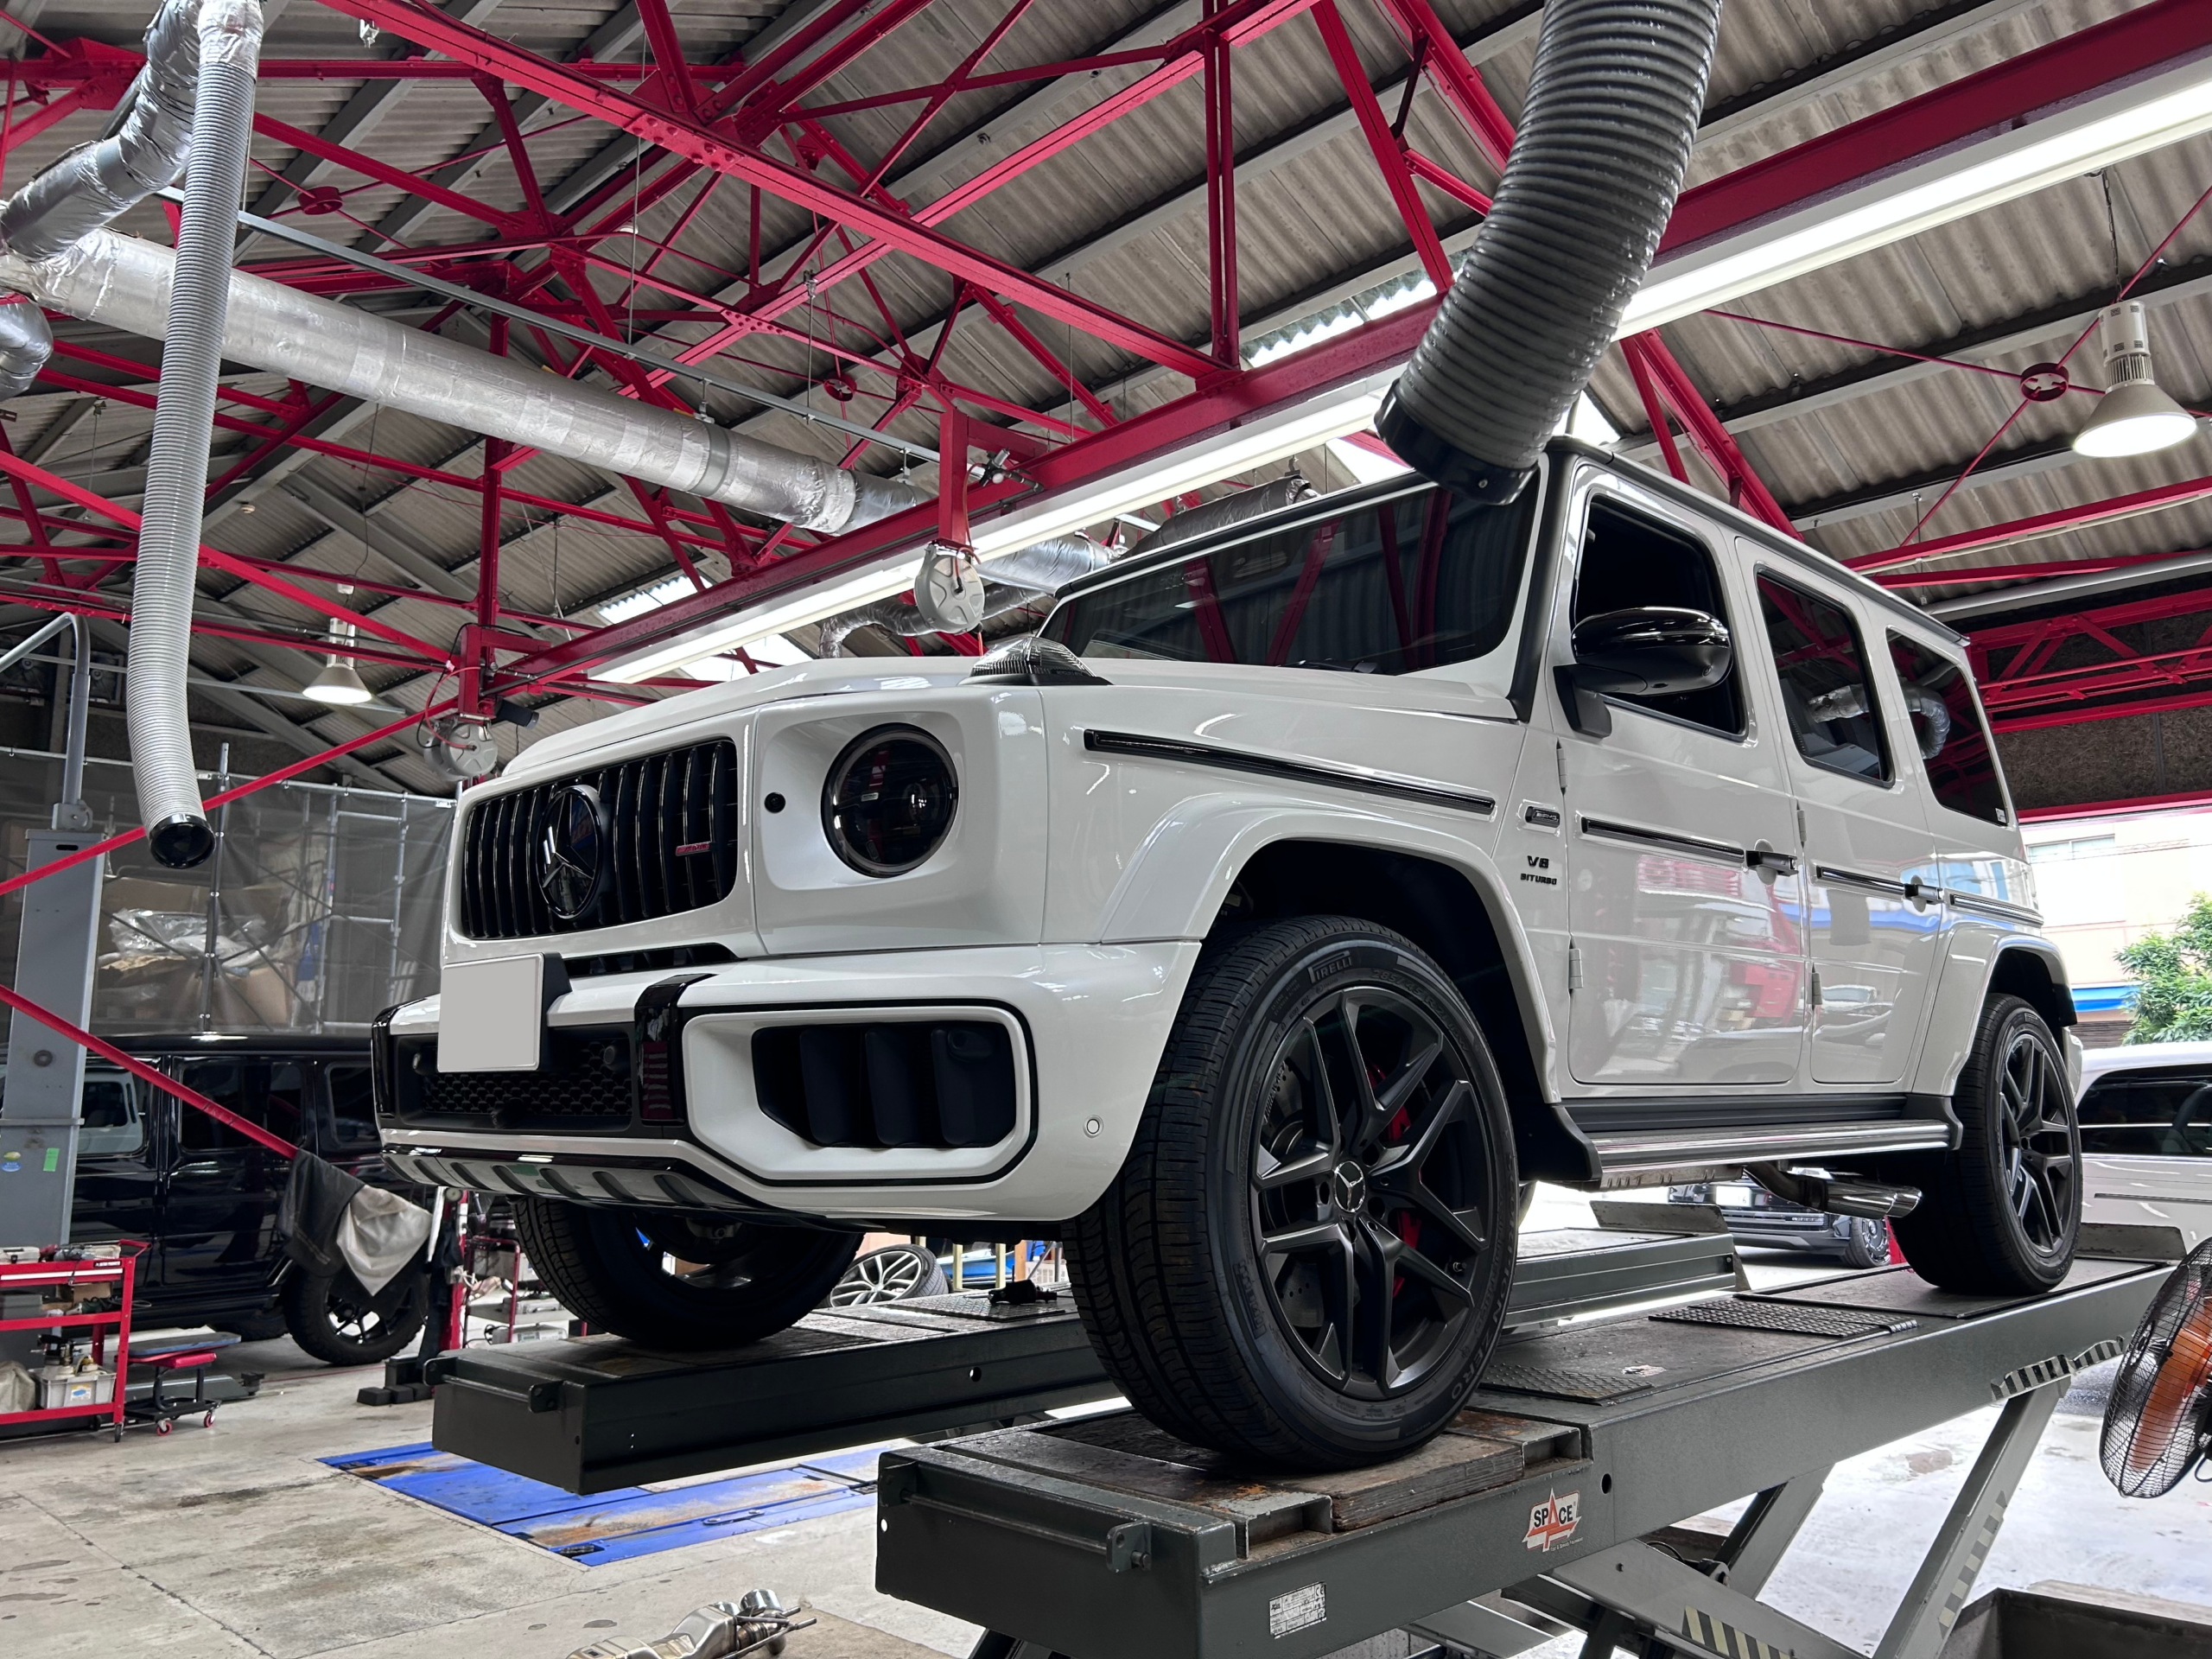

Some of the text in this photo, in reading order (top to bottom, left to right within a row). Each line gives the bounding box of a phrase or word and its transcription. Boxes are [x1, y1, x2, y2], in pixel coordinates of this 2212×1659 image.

[1527, 855, 1549, 868] V8
[1521, 873, 1557, 885] BITURBO
[1306, 950, 1353, 984] PIRELLI
[1451, 1325, 1495, 1401] ZERO
[1534, 1497, 1573, 1528] SPACE
